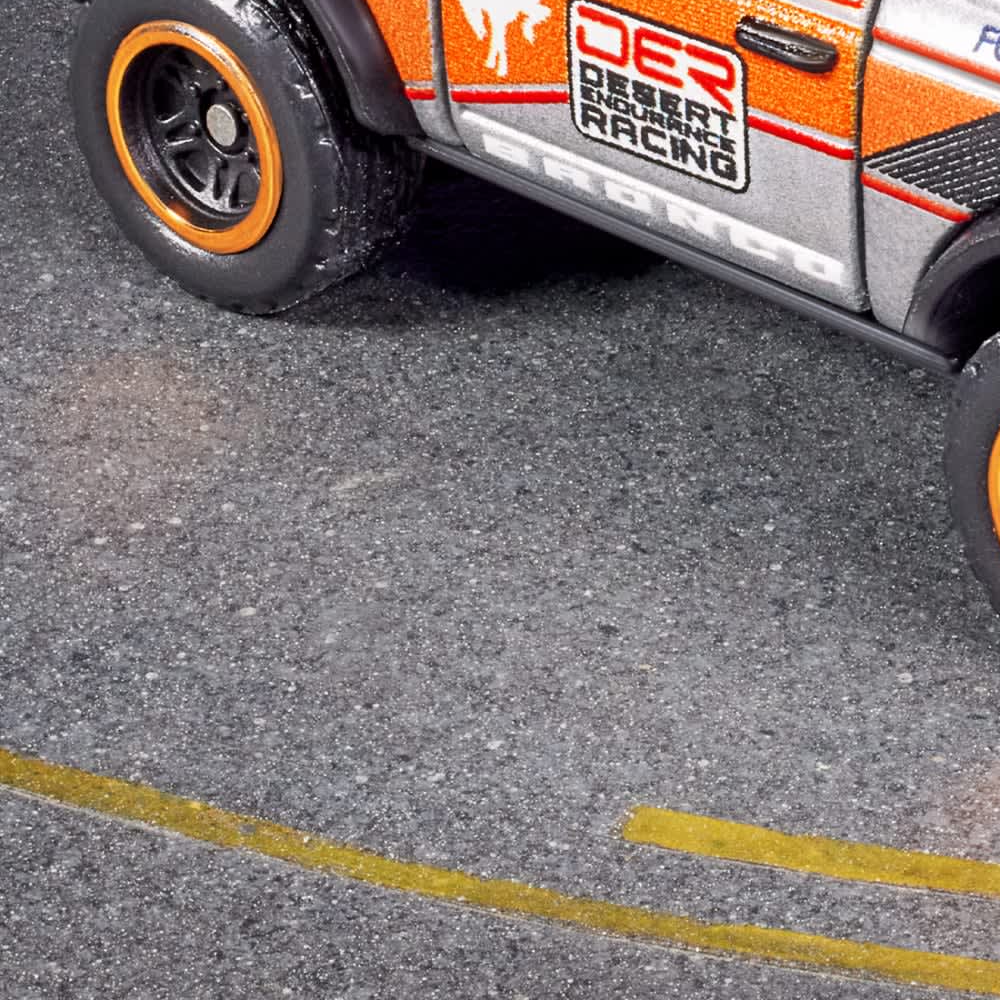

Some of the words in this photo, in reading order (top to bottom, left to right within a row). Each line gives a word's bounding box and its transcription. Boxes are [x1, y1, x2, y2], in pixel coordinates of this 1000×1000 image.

[578, 59, 737, 136] DESERT
[579, 84, 737, 155] ENDURANCE
[580, 102, 738, 182] RACING
[482, 133, 845, 287] BRONCO
